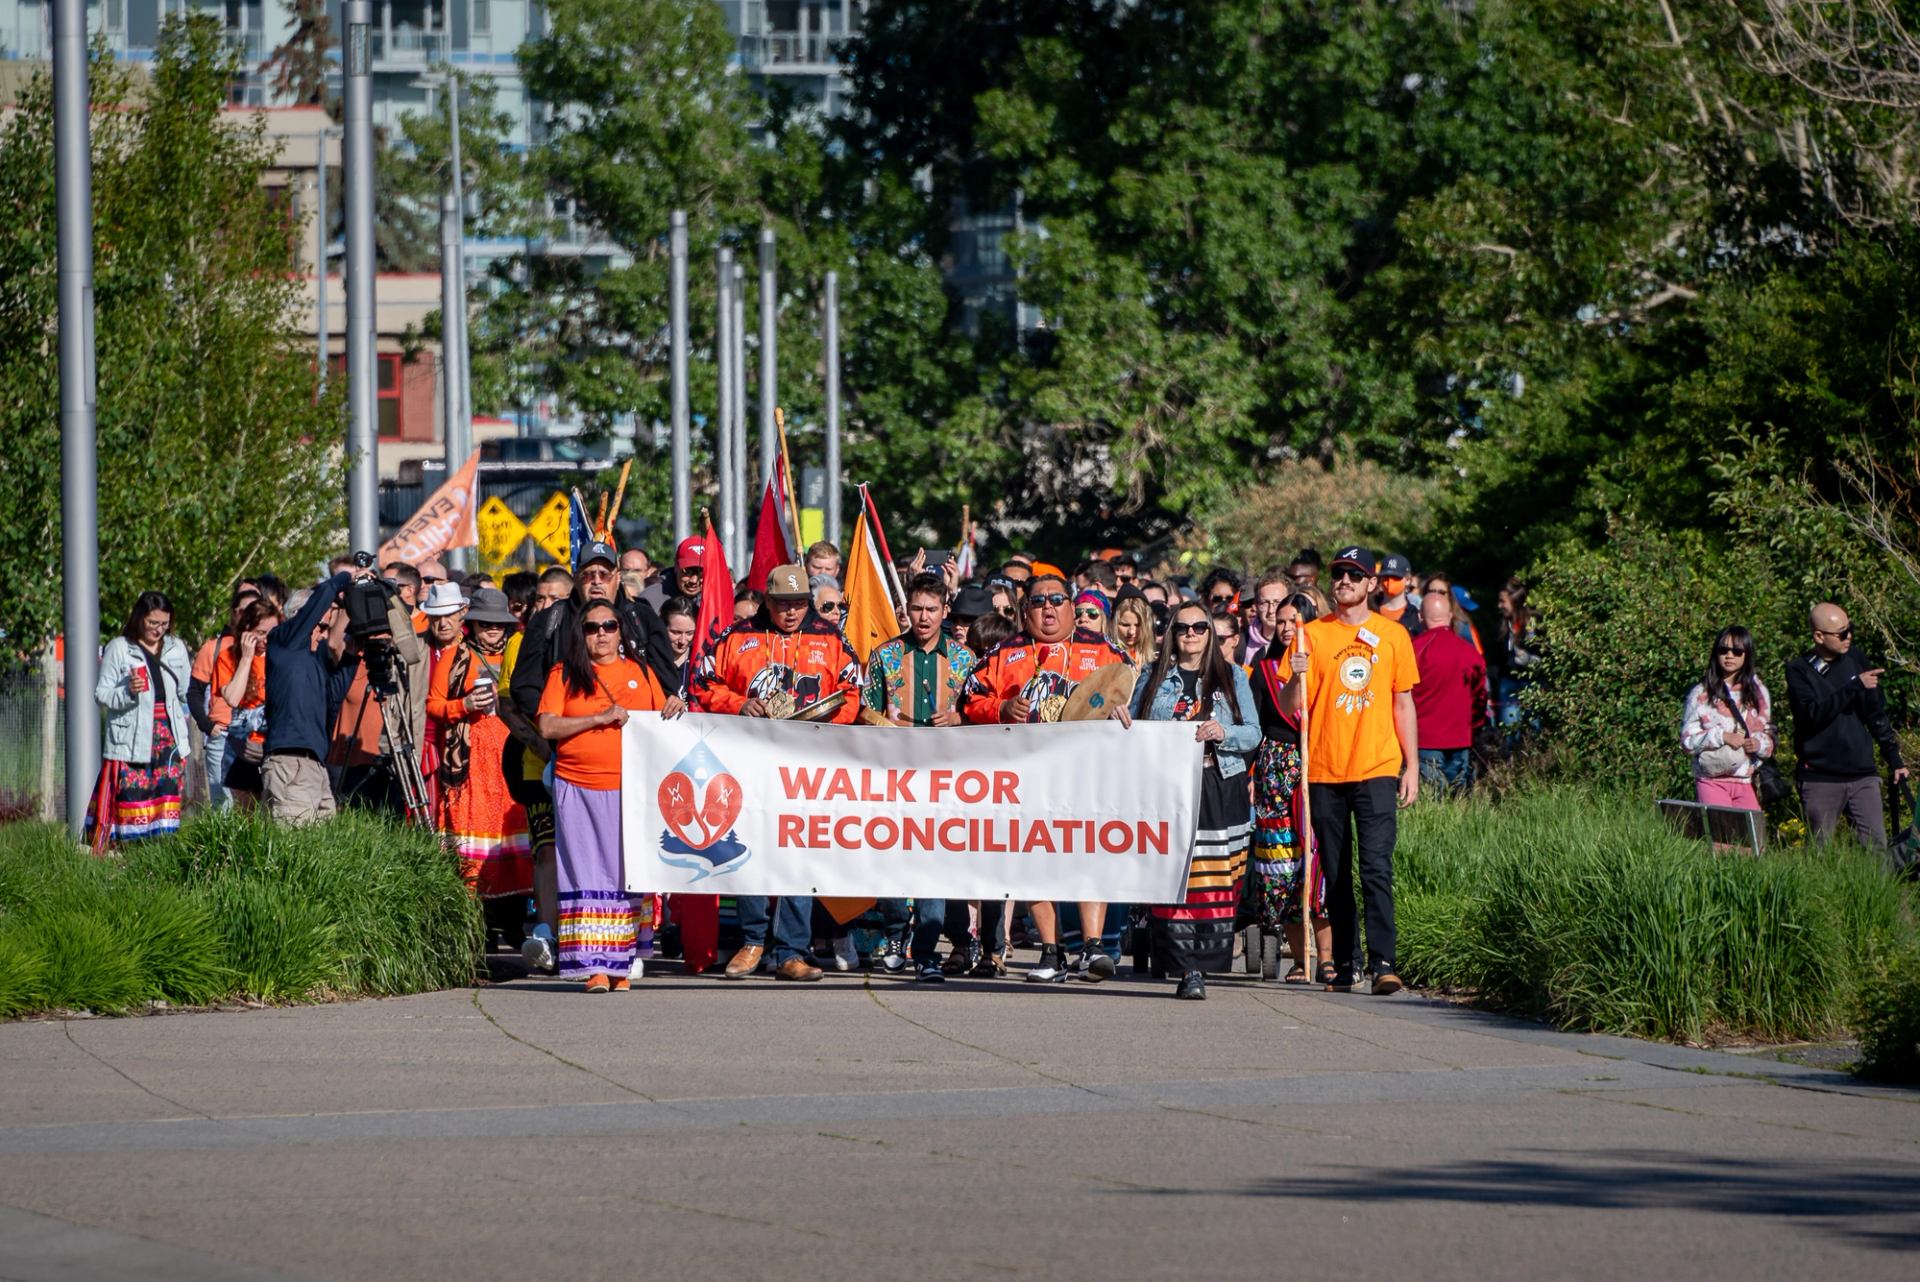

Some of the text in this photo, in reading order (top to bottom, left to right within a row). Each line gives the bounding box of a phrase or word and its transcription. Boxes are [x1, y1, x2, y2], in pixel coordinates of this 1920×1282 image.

[779, 767, 1020, 804] WALK FOR
[778, 814, 1169, 855] RECONCILIATION
